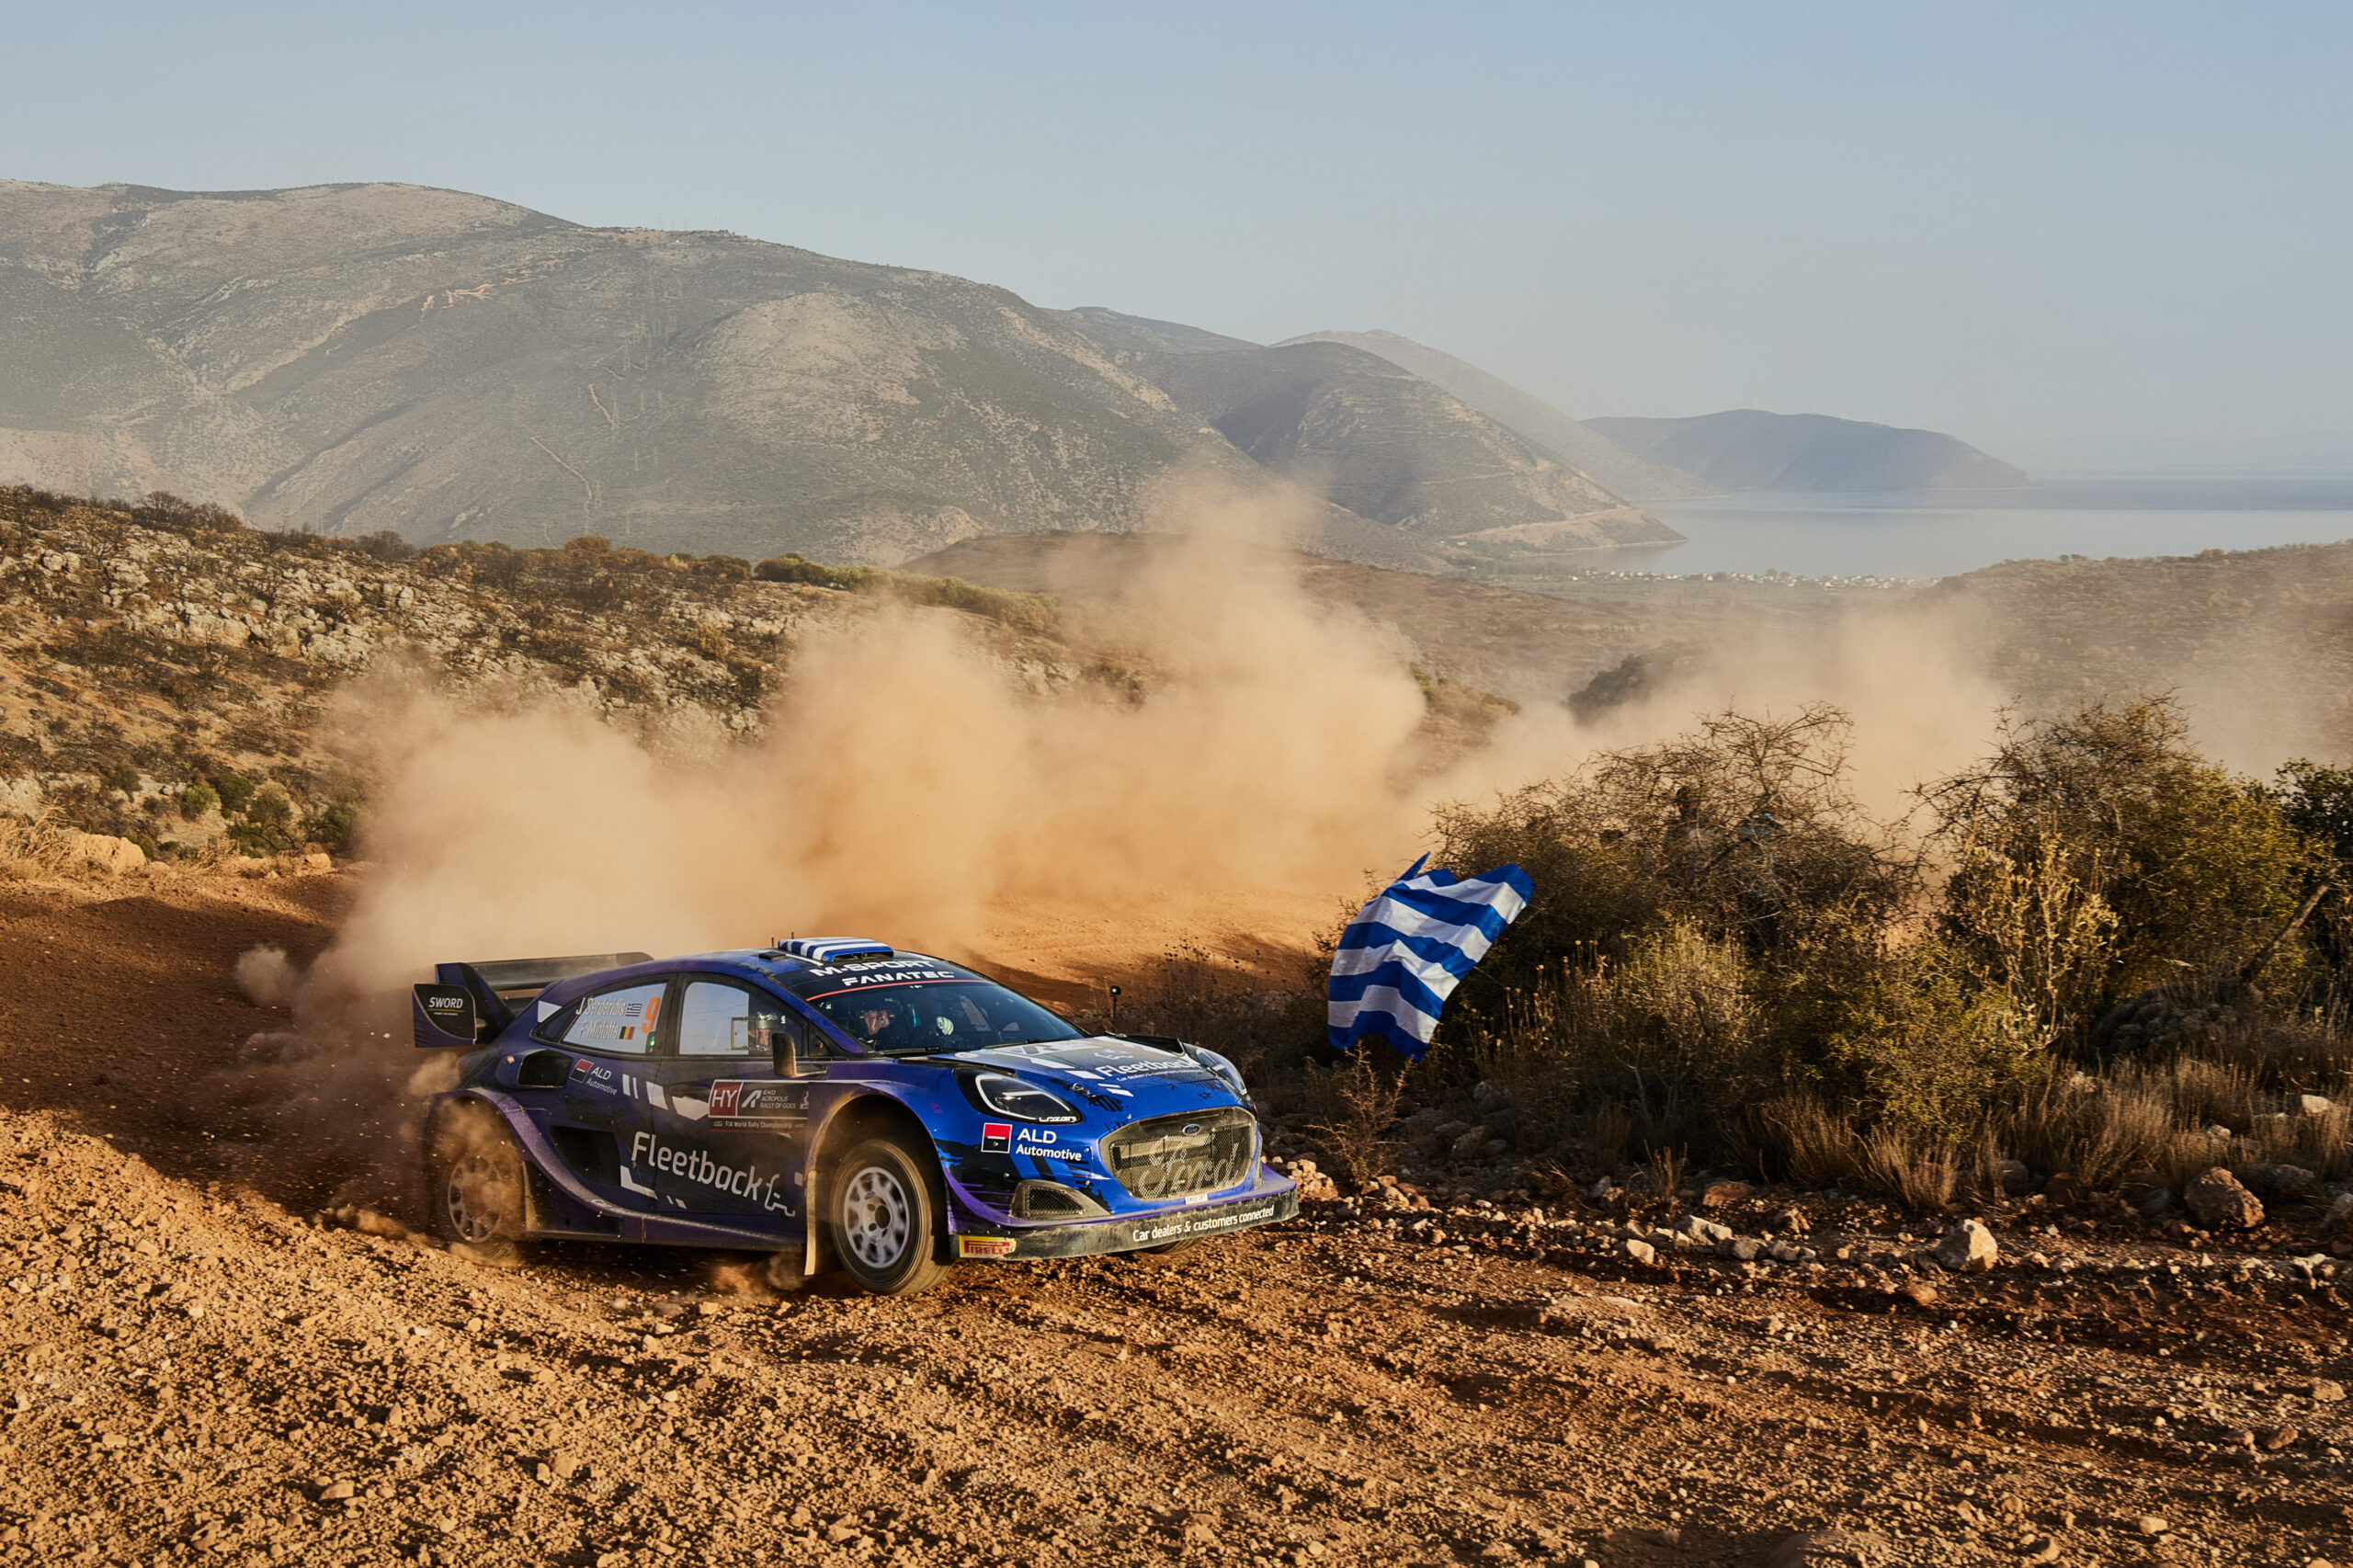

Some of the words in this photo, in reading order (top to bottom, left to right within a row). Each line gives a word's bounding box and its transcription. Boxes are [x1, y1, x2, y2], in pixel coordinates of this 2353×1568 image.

[809, 960, 935, 977] M-SPORT
[841, 971, 954, 987] FANATEC
[428, 997, 463, 1009] SWORD
[575, 997, 586, 1016] J
[642, 996, 661, 1034] 9
[578, 1021, 588, 1039] F
[591, 1066, 612, 1081] ALD
[1096, 1059, 1202, 1077] Fleetback
[585, 1077, 619, 1096] Automotive
[711, 1089, 738, 1108] HY
[1017, 1128, 1057, 1144] ALD
[1016, 1143, 1082, 1162] Automotive
[631, 1131, 763, 1201] Fleetback
[1138, 1133, 1239, 1199] Ford
[1132, 1229, 1150, 1243] Car
[1152, 1224, 1182, 1240] dealers
[1183, 1221, 1192, 1233] &
[1193, 1215, 1238, 1232] customers
[1239, 1204, 1275, 1223] connected
